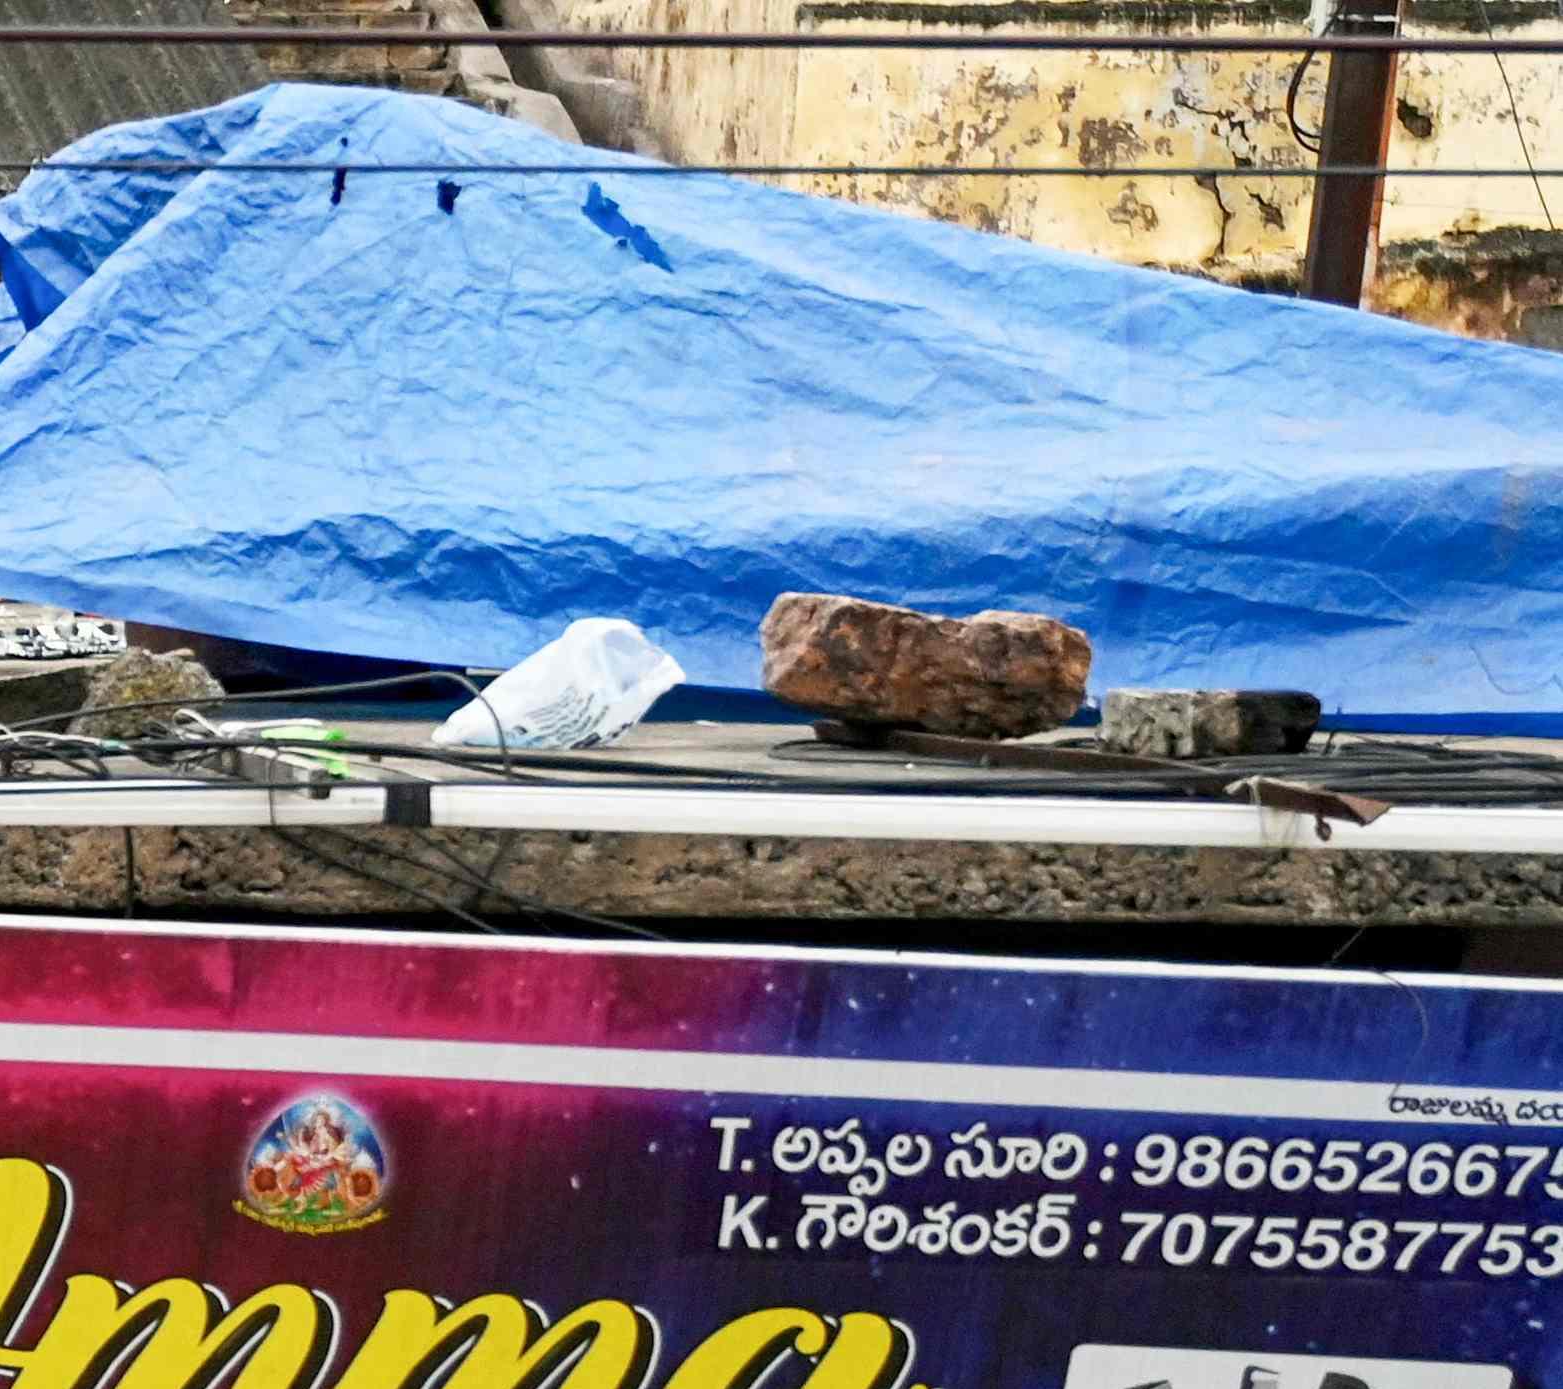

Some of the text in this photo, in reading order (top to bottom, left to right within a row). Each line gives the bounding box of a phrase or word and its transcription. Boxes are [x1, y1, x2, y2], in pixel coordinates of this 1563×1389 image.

[708, 1117, 756, 1174] T.
[771, 1126, 934, 1199] అప్పల
[716, 1194, 781, 1251] K.
[1119, 1210, 1563, 1277] 7075587753
